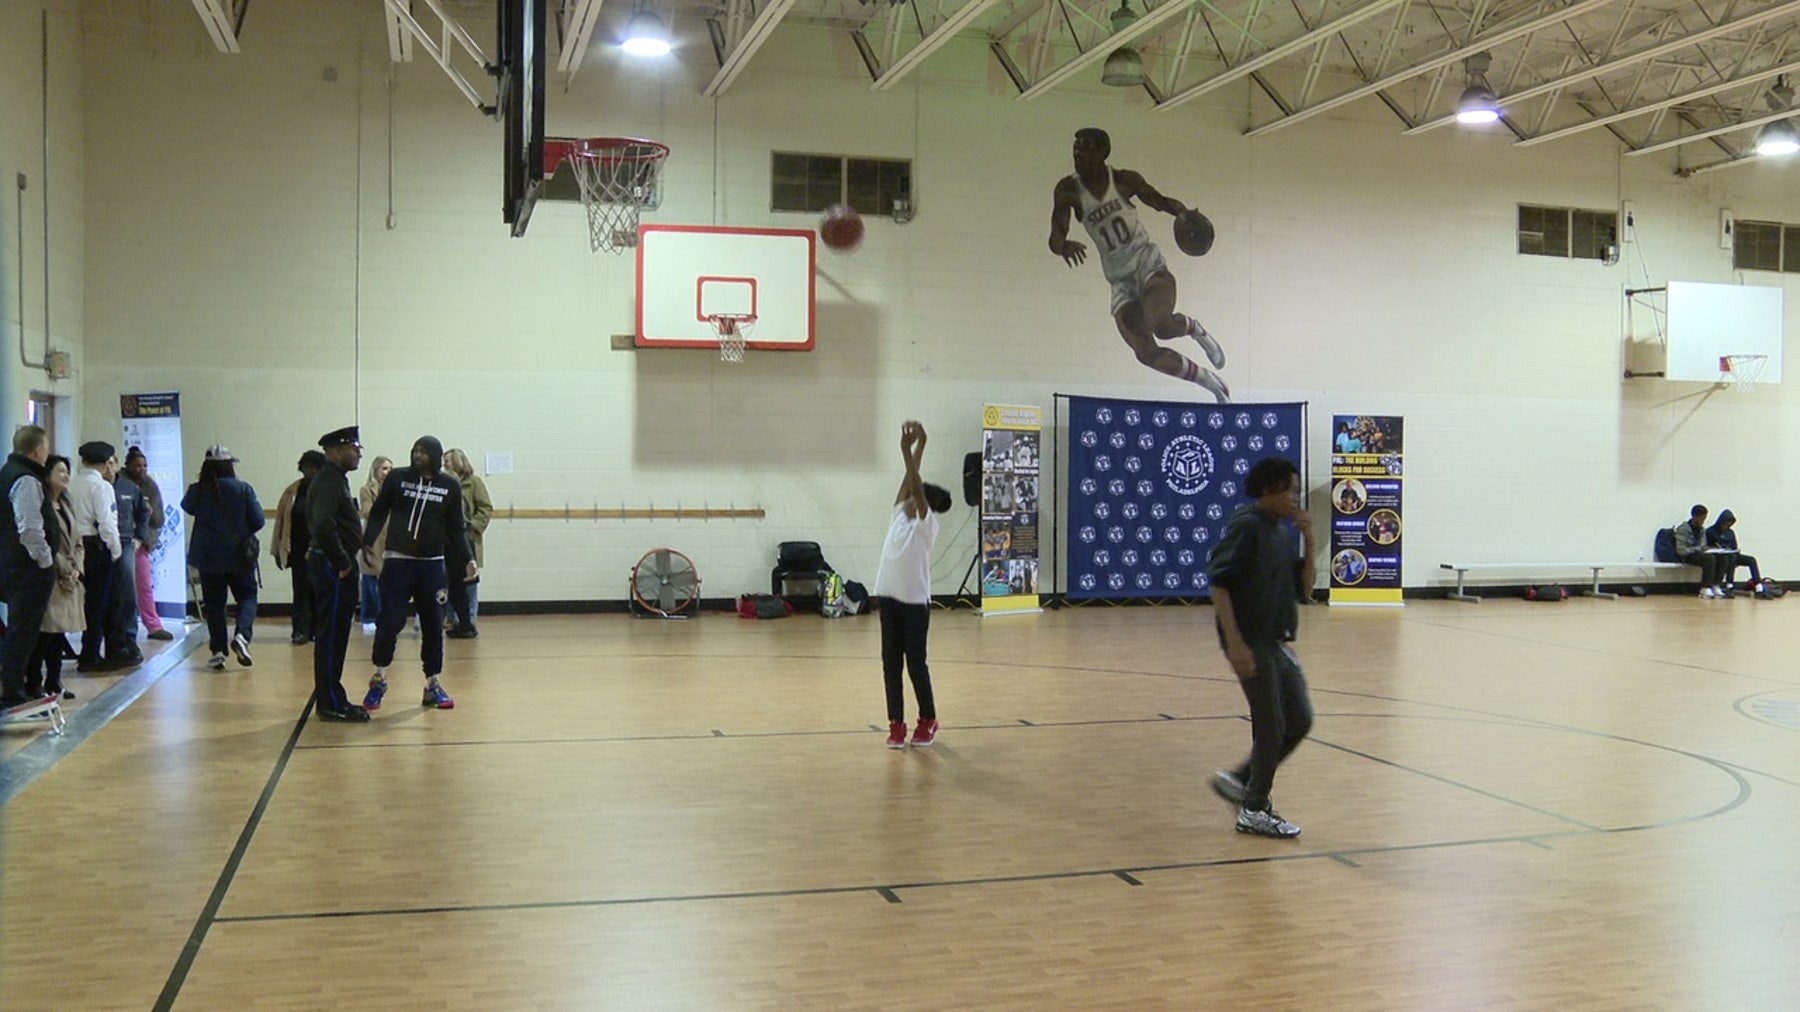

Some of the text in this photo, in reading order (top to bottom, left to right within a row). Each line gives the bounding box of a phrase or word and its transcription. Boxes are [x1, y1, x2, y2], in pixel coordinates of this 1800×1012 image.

[1100, 216, 1131, 251] 10
[1161, 435, 1214, 473] POLICE ATHLETIC LEAGUE
[1352, 465, 1362, 473] FOR
[1166, 478, 1209, 495] PHILADELPHIA
